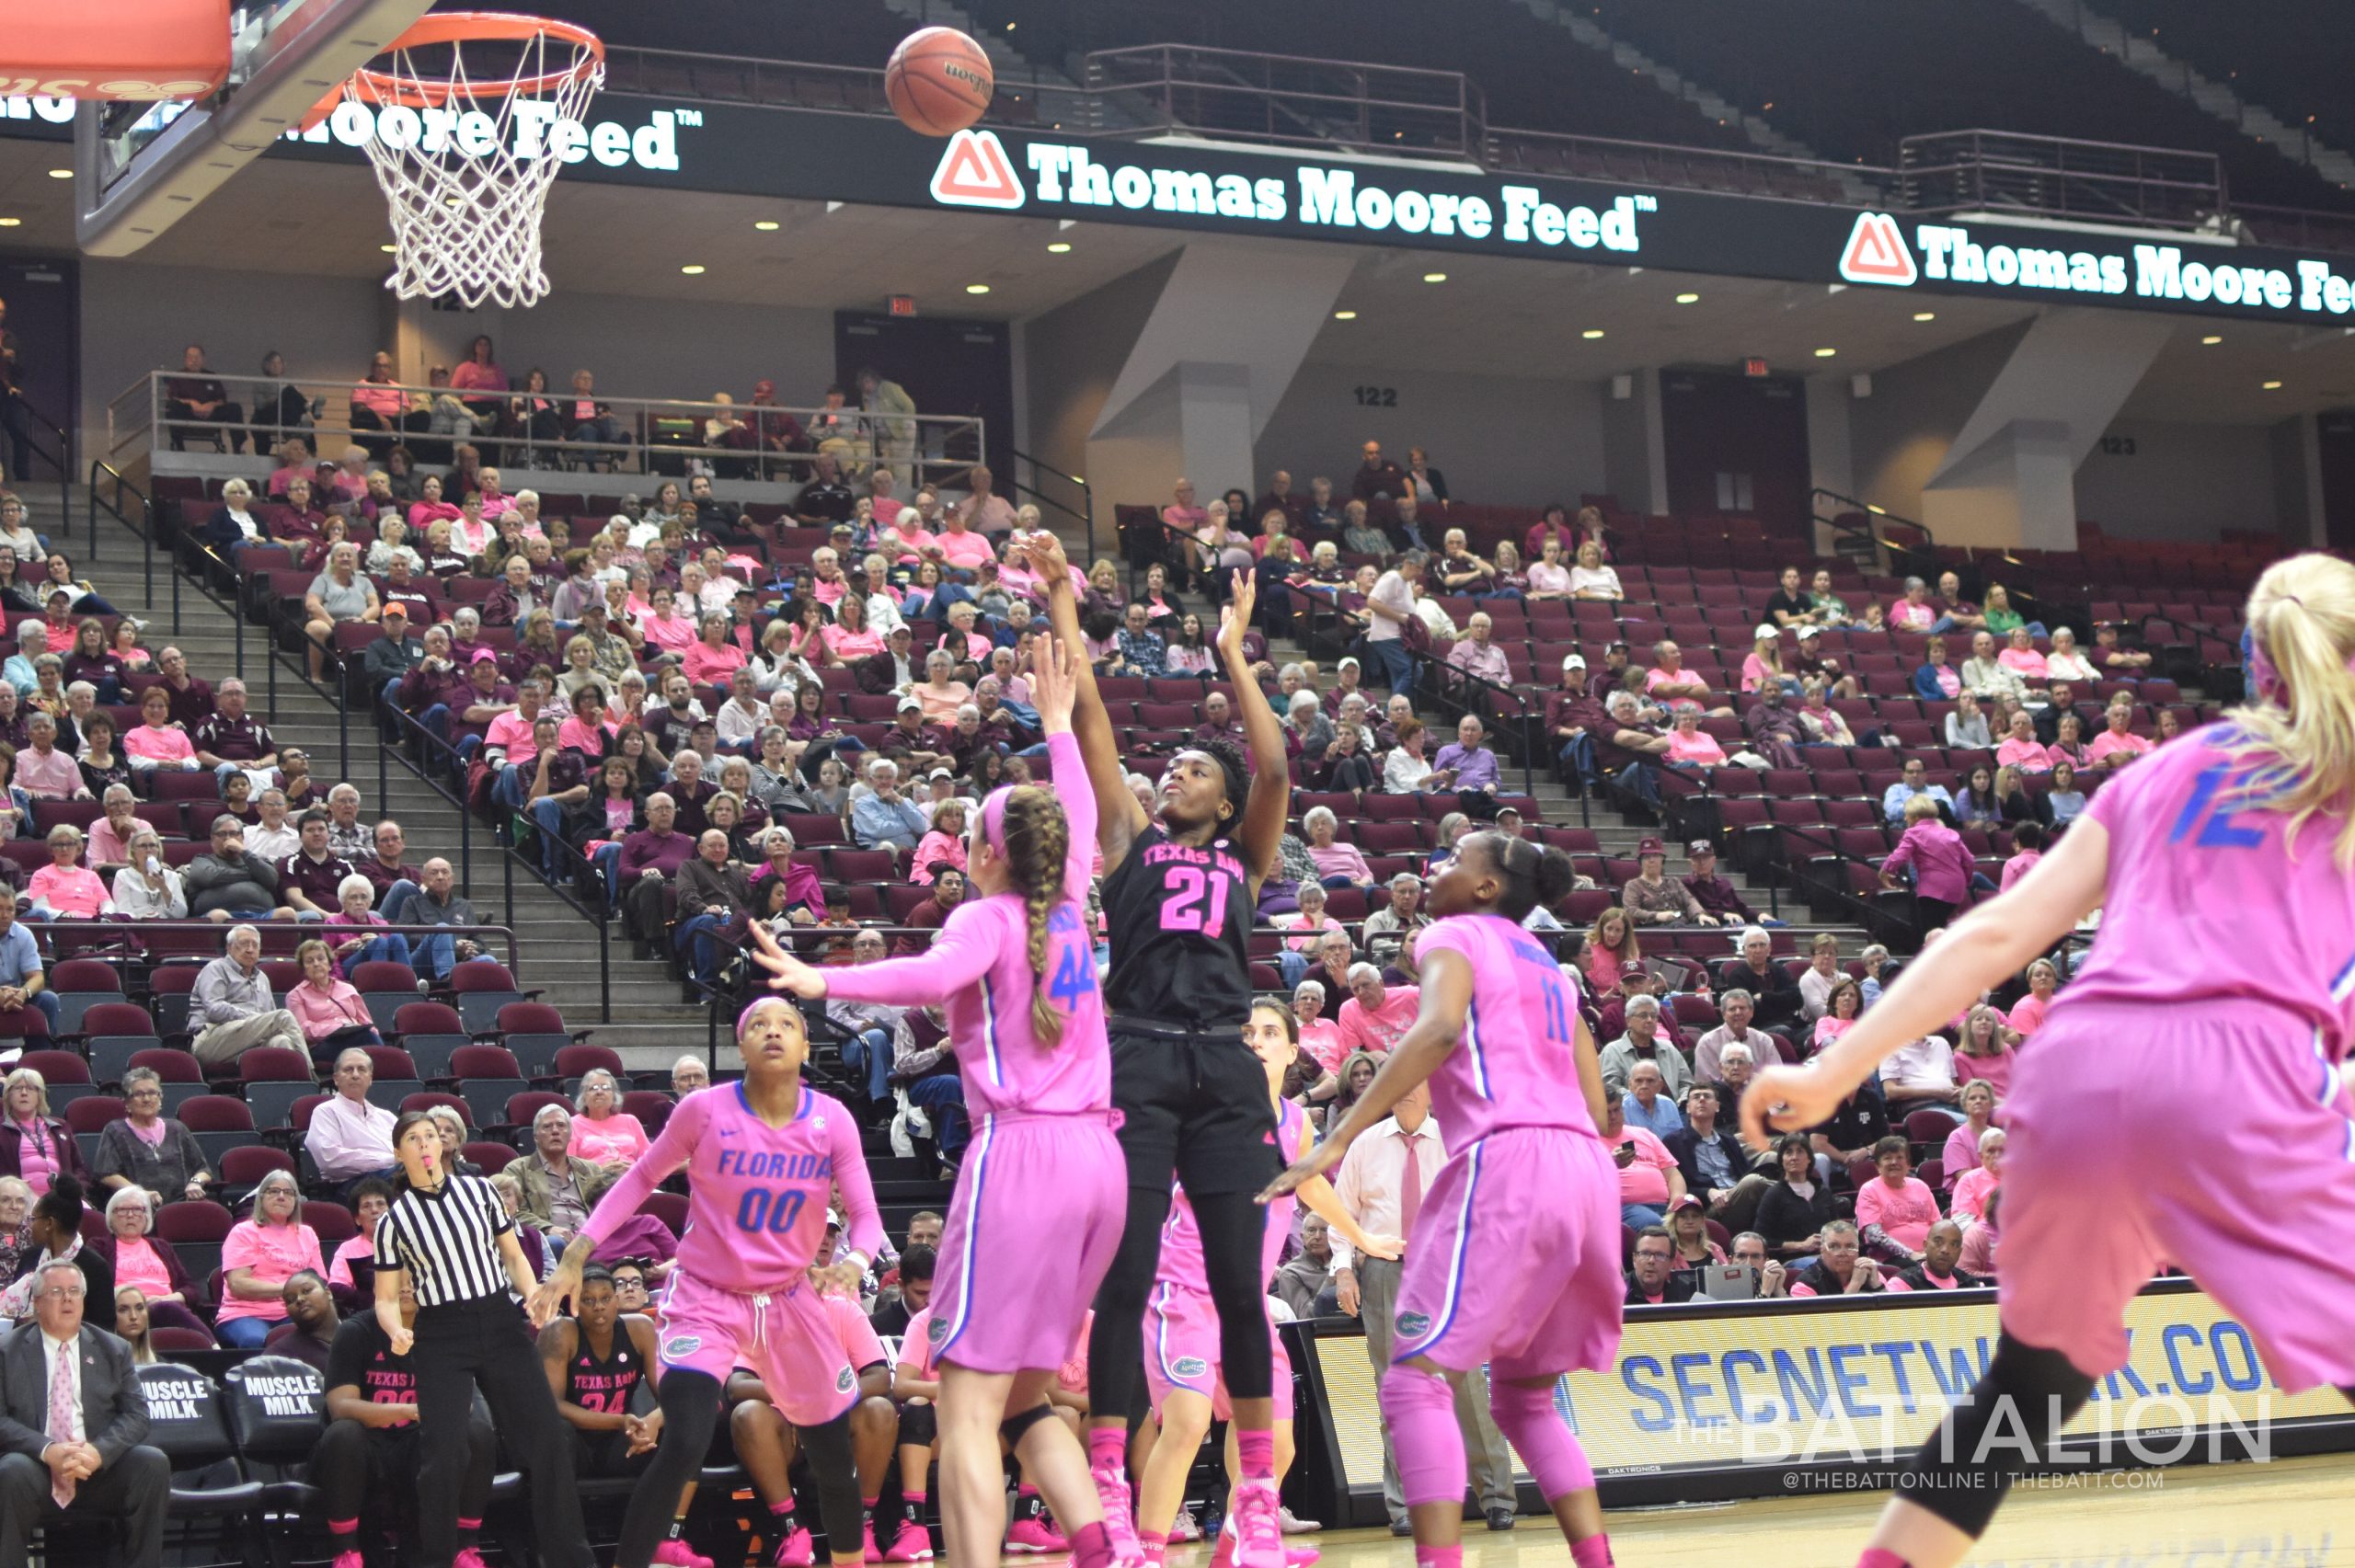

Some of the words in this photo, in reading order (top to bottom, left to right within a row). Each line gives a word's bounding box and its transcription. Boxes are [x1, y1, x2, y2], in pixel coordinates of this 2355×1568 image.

[1028, 143, 1287, 221] Thomas
[1298, 166, 1492, 239] Moore
[1917, 224, 2127, 294] Thomas
[2133, 245, 2292, 309] Moore
[2297, 259, 2355, 315] Fe
[1354, 386, 1397, 407] 122
[2099, 437, 2137, 456] 123
[1143, 842, 1212, 866] TEXAS
[1160, 866, 1229, 939] 21
[1051, 941, 1096, 1013] 44
[1541, 976, 1569, 1044] 11
[718, 1149, 832, 1180] FLORIDA
[737, 1187, 807, 1233] 00
[245, 1376, 321, 1396] MUSCLE
[366, 1370, 408, 1387] TEXAS
[575, 1375, 612, 1390] TEXAS
[1607, 1465, 1661, 1474] DAKTRONICS
